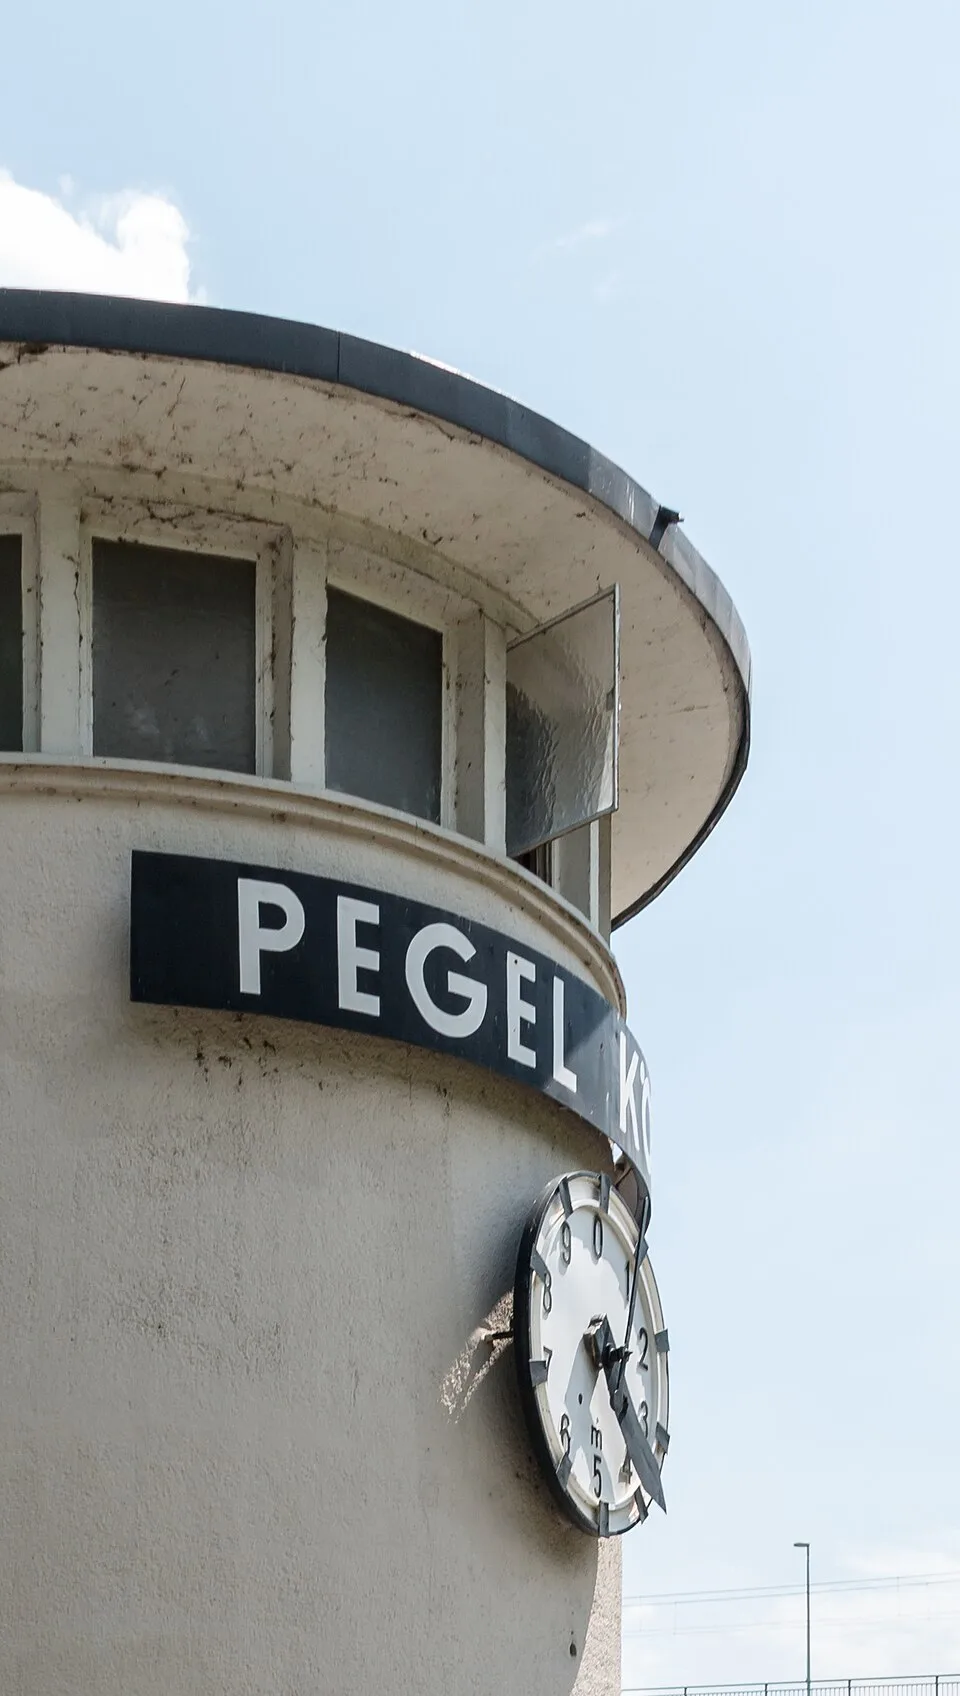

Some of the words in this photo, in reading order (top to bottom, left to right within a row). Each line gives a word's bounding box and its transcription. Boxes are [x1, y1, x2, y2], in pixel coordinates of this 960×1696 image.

[237, 877, 577, 1093] PEGEL
[561, 1220, 572, 1265] 9
[592, 1215, 604, 1260] 0
[541, 1272, 552, 1313] 8
[638, 1327, 649, 1372] 2
[593, 1454, 602, 1498] 5
